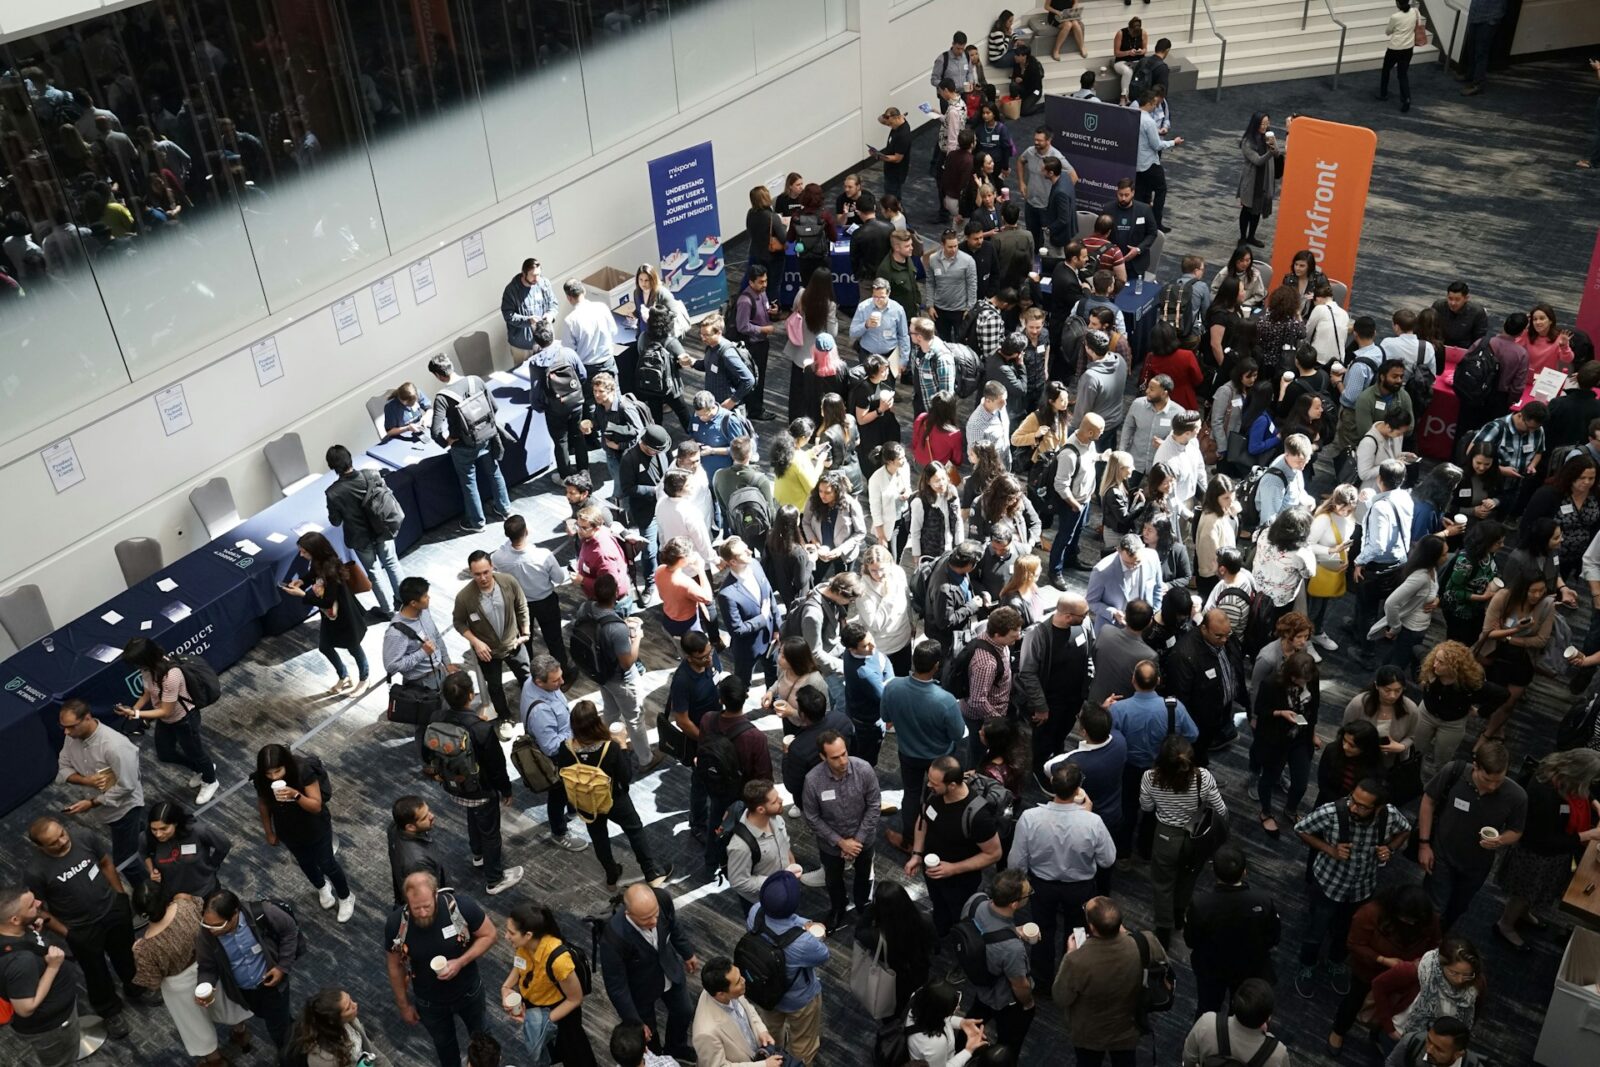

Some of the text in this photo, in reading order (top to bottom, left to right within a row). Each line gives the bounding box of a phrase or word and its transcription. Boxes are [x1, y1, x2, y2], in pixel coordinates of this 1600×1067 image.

[1061, 130, 1119, 147] PRODUCT SCHOOL
[668, 159, 697, 175] mixpanel
[665, 178, 704, 196] UNDERSTAND
[666, 187, 705, 206] EVERY USER'S
[666, 195, 708, 216] JOURNEY WITH
[662, 204, 713, 226] INSTANT INSIGHTS
[1303, 160, 1339, 273] orkfront
[16, 689, 36, 702] SCHOOL
[23, 684, 47, 700] PRODUCT
[56, 859, 91, 882] Value.
